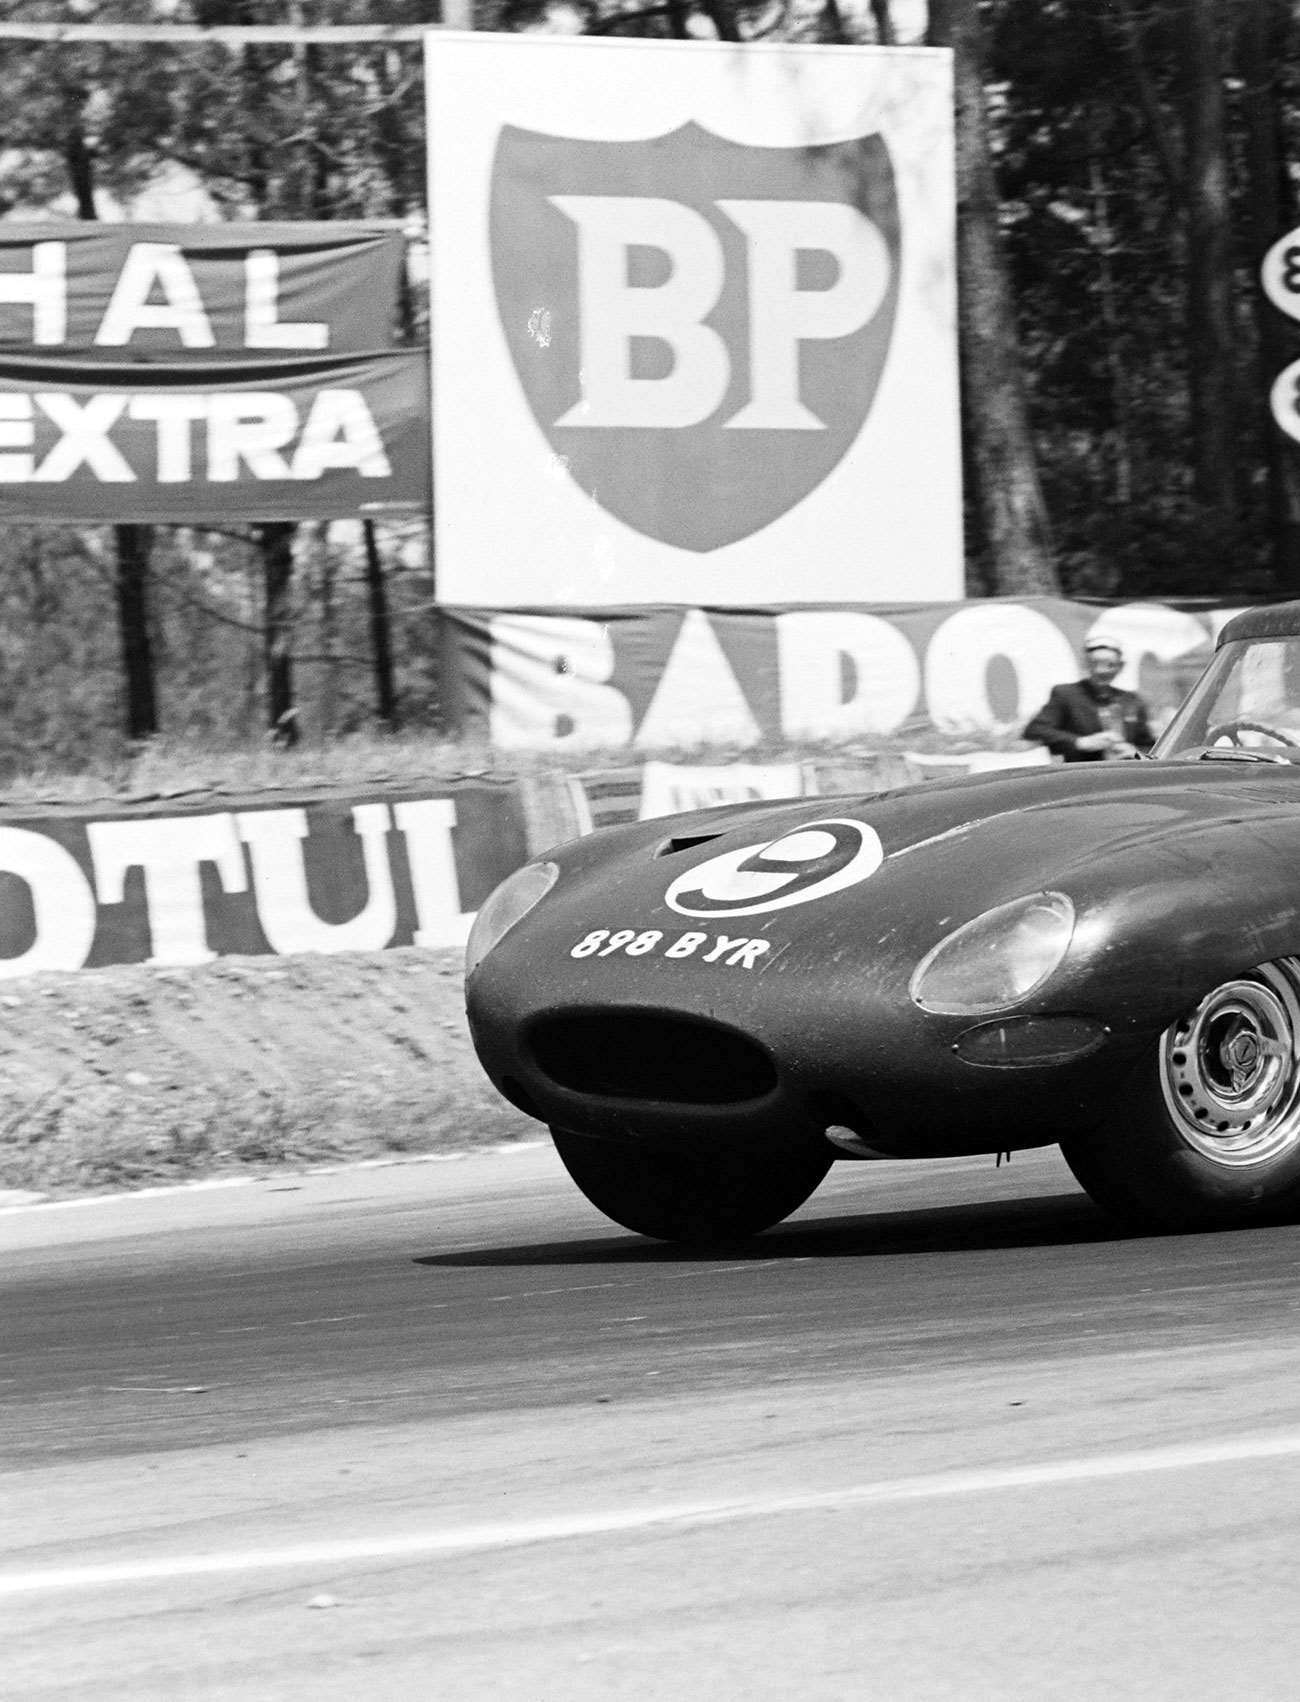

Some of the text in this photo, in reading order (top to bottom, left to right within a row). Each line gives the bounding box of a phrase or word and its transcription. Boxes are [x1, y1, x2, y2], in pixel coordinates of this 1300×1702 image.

[546, 194, 891, 430] BP
[0, 389, 392, 483] EXTRA
[675, 823, 863, 911] 9
[570, 929, 771, 969] 898 BYR
